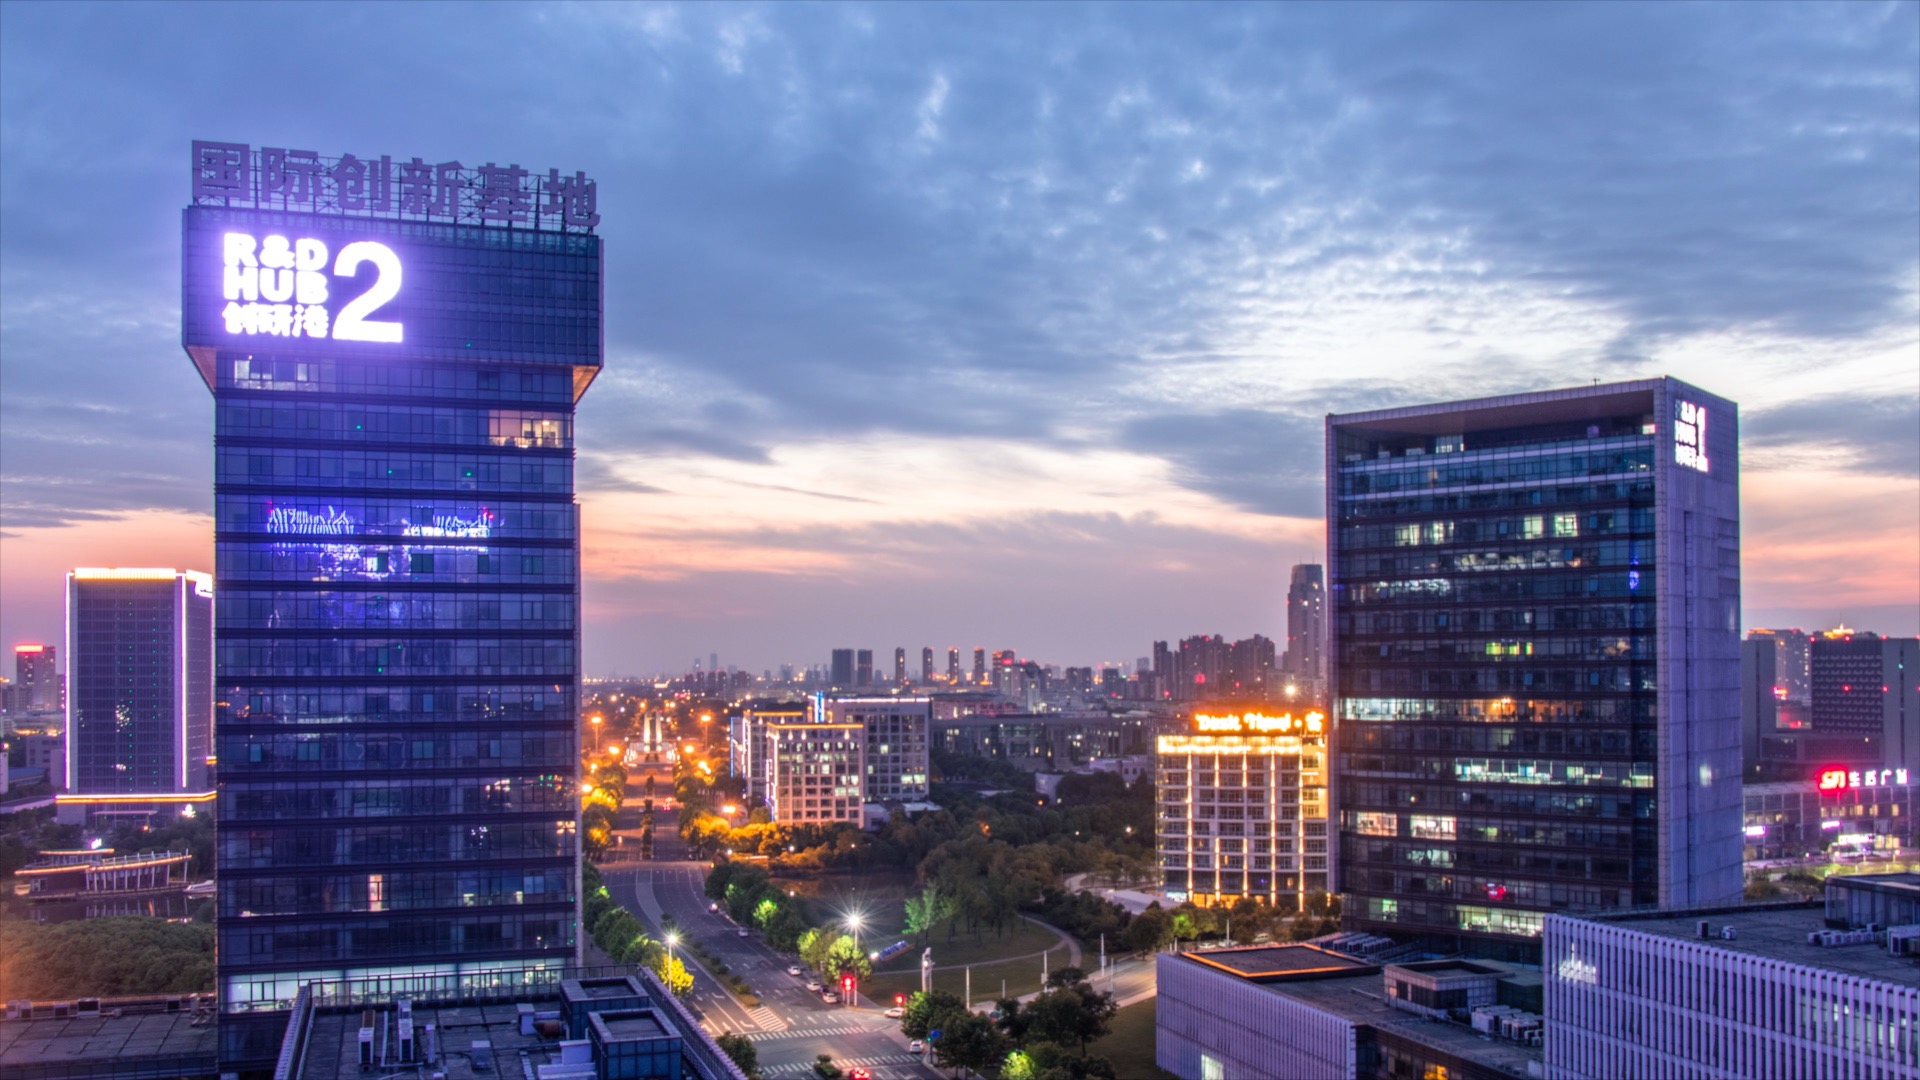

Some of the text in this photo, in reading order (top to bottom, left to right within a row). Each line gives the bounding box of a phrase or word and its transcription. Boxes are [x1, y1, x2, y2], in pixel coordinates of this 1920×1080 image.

[192, 140, 600, 227] 国际创新基地
[223, 232, 329, 271] R&D
[223, 265, 329, 304] HUB
[332, 241, 403, 343] 2
